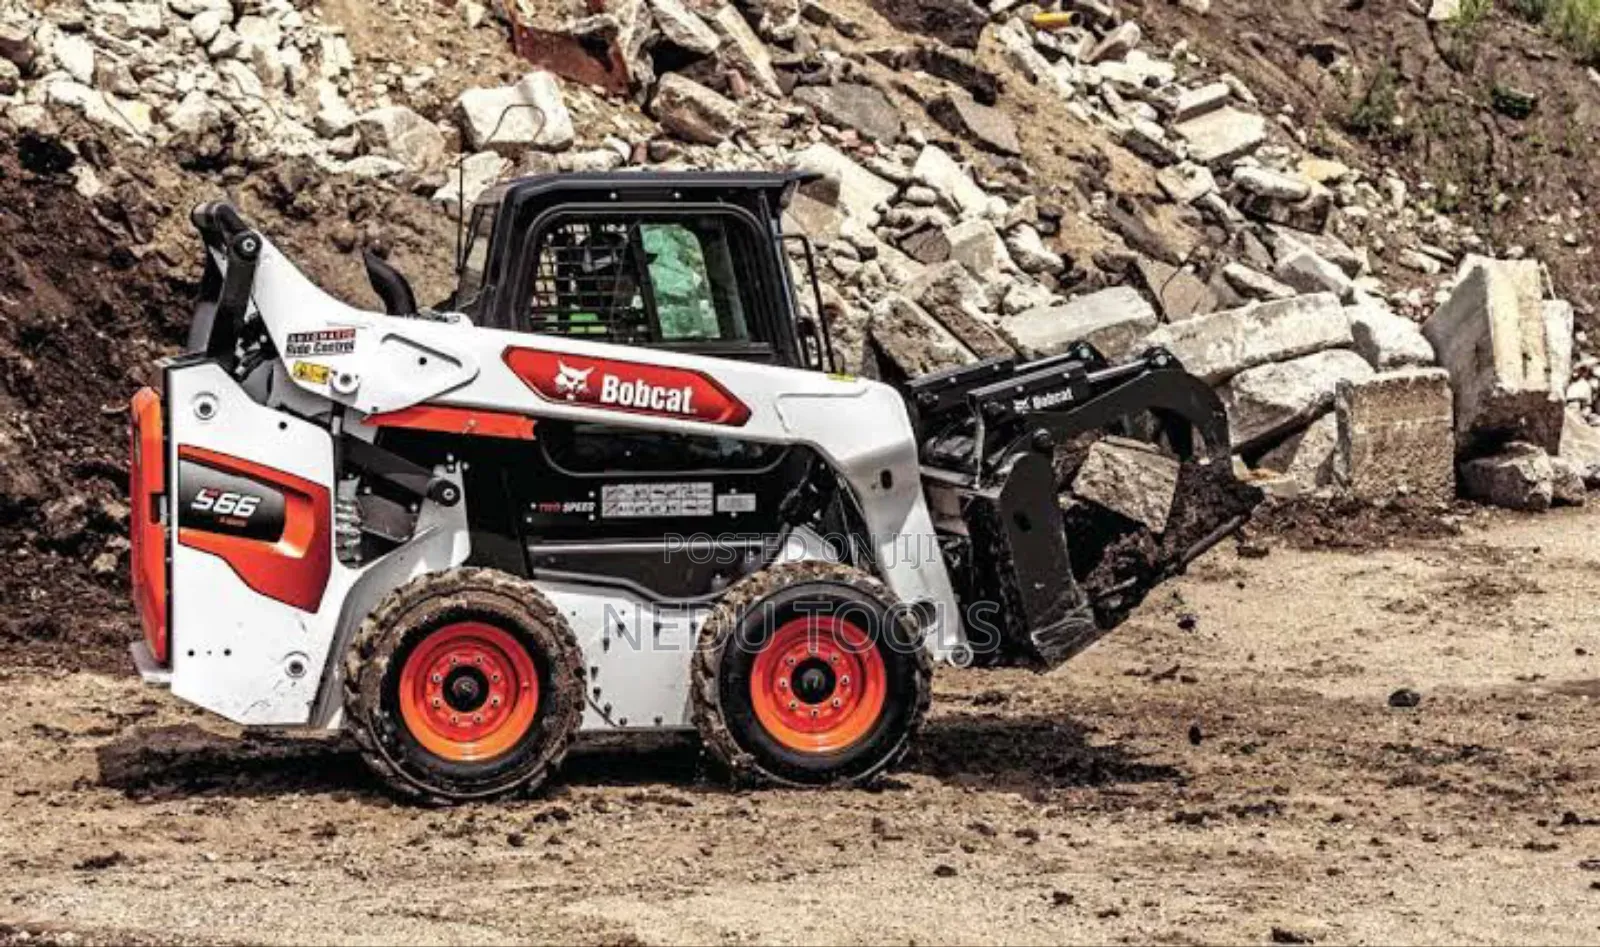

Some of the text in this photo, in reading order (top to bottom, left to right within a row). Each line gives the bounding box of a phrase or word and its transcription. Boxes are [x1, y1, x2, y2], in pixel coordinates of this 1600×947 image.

[313, 339, 356, 354] Control
[601, 374, 694, 415] Bobcat
[1032, 387, 1074, 410] Bobcat
[191, 488, 261, 518] S66
[562, 501, 596, 514] SPEED
